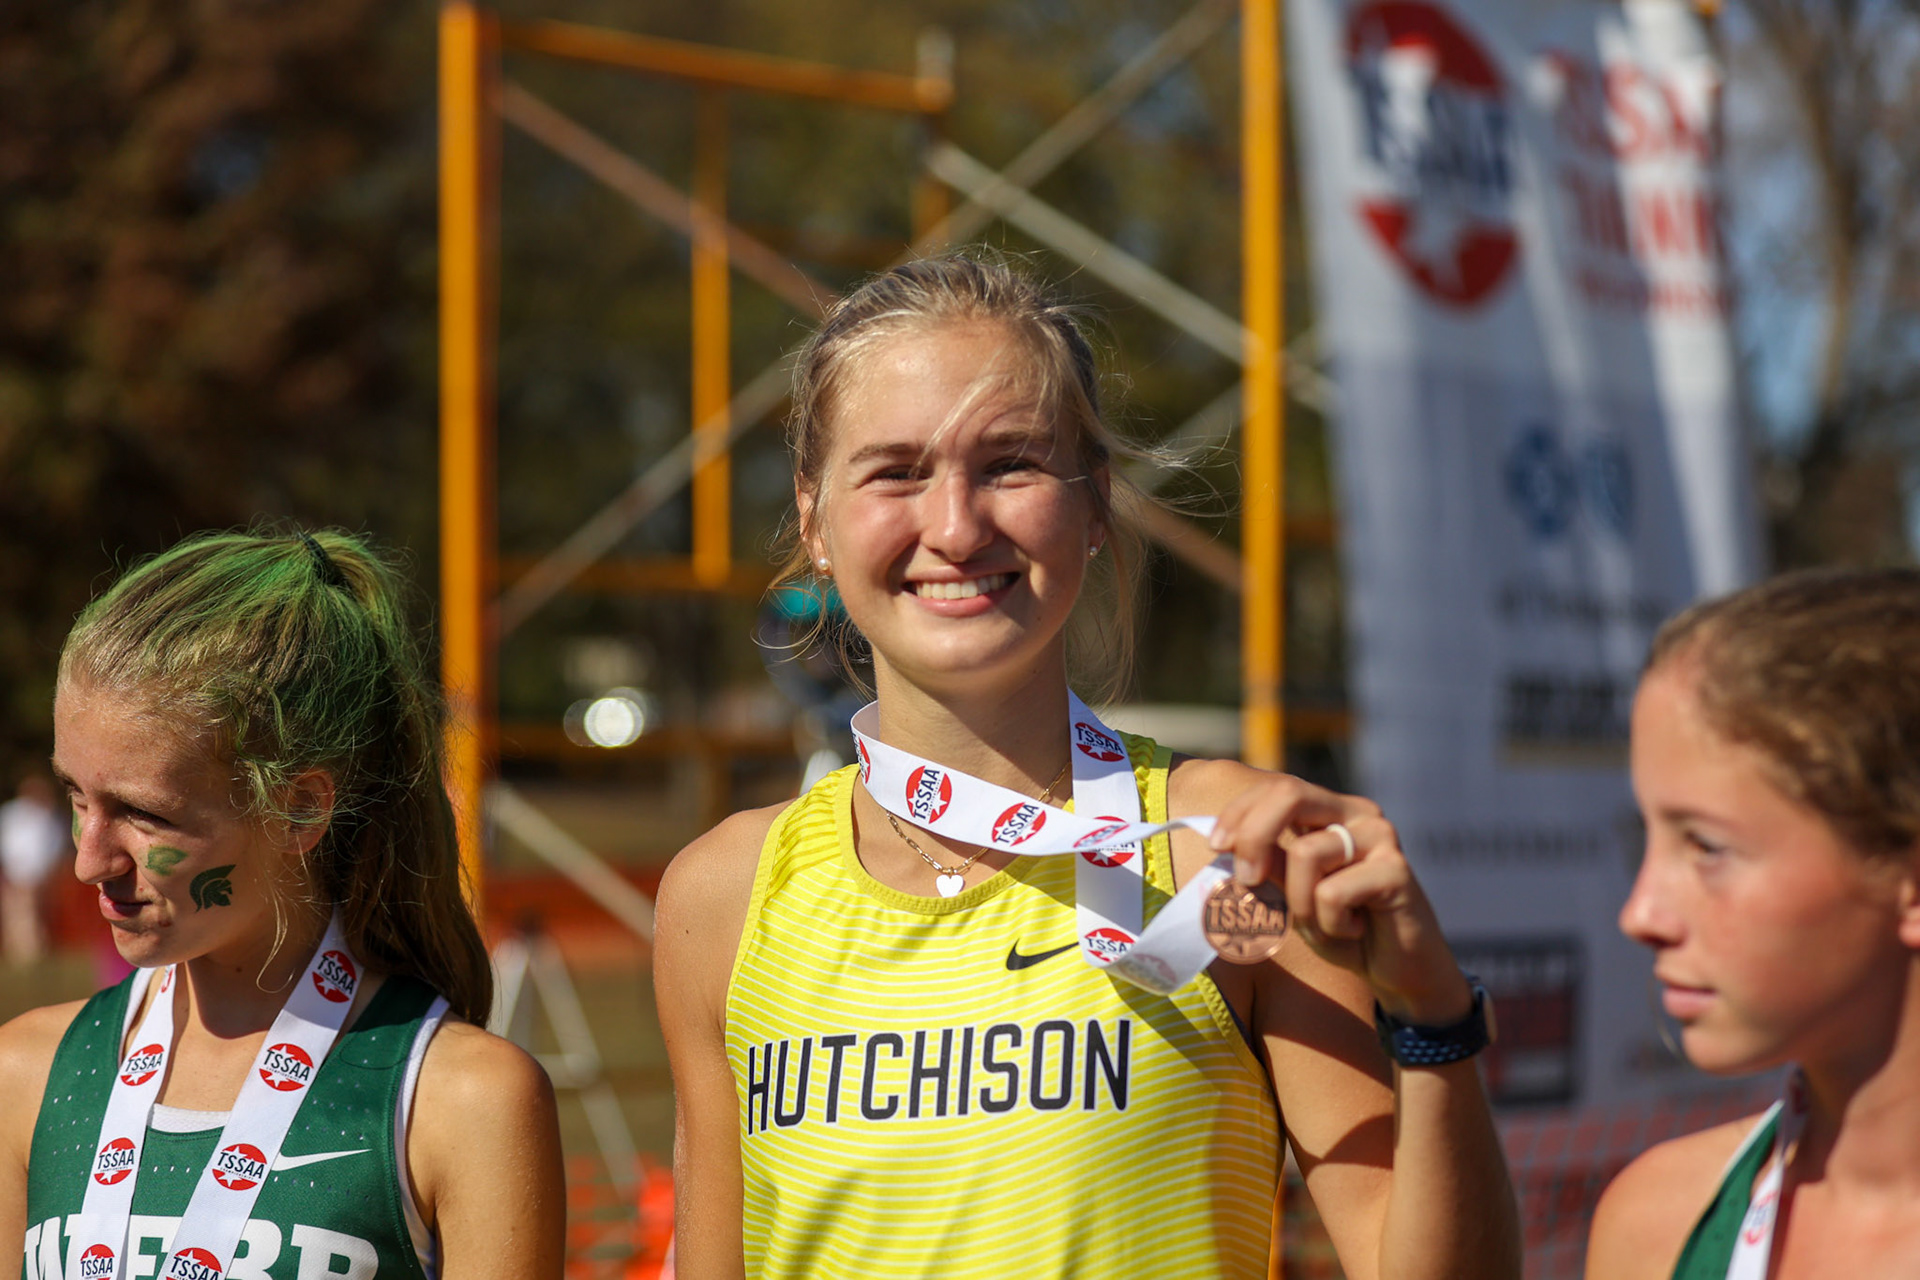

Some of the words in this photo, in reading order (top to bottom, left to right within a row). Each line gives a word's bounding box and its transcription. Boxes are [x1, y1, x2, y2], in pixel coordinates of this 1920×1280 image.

[1075, 726, 1124, 755] TSSAA
[913, 768, 940, 820] TSSAA
[996, 803, 1039, 843] TSSAA
[1087, 937, 1129, 953] TSSA
[317, 955, 355, 995] TSSAA
[125, 1053, 163, 1072] TSSAA
[263, 1049, 311, 1081] TSSAA
[747, 1018, 1131, 1136] HUTCHISON
[97, 1148, 135, 1170] TSSAA
[217, 1151, 265, 1179] TSSAA
[80, 1257, 113, 1279] TSSAA
